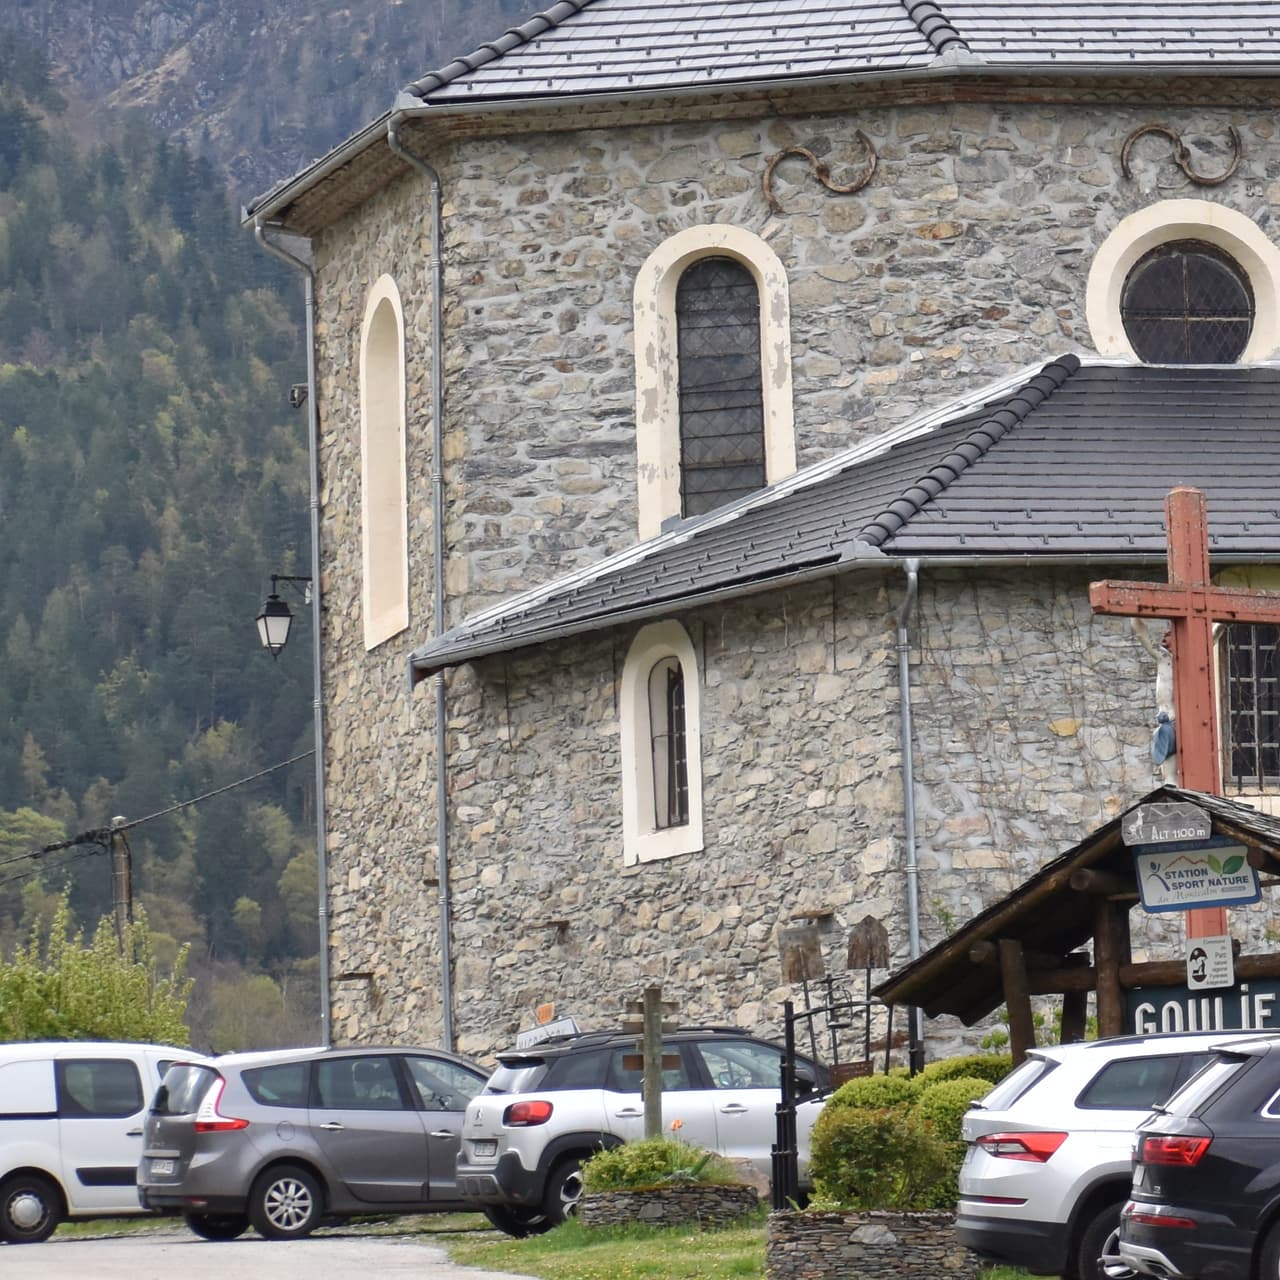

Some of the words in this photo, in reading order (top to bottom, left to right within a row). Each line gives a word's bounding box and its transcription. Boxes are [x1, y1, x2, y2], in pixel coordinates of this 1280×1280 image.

[1173, 827, 1195, 839] 1100
[1196, 829, 1206, 837] m
[1164, 867, 1209, 880] STATION
[1171, 879, 1206, 891] SPORT
[1207, 875, 1249, 887] NATURE
